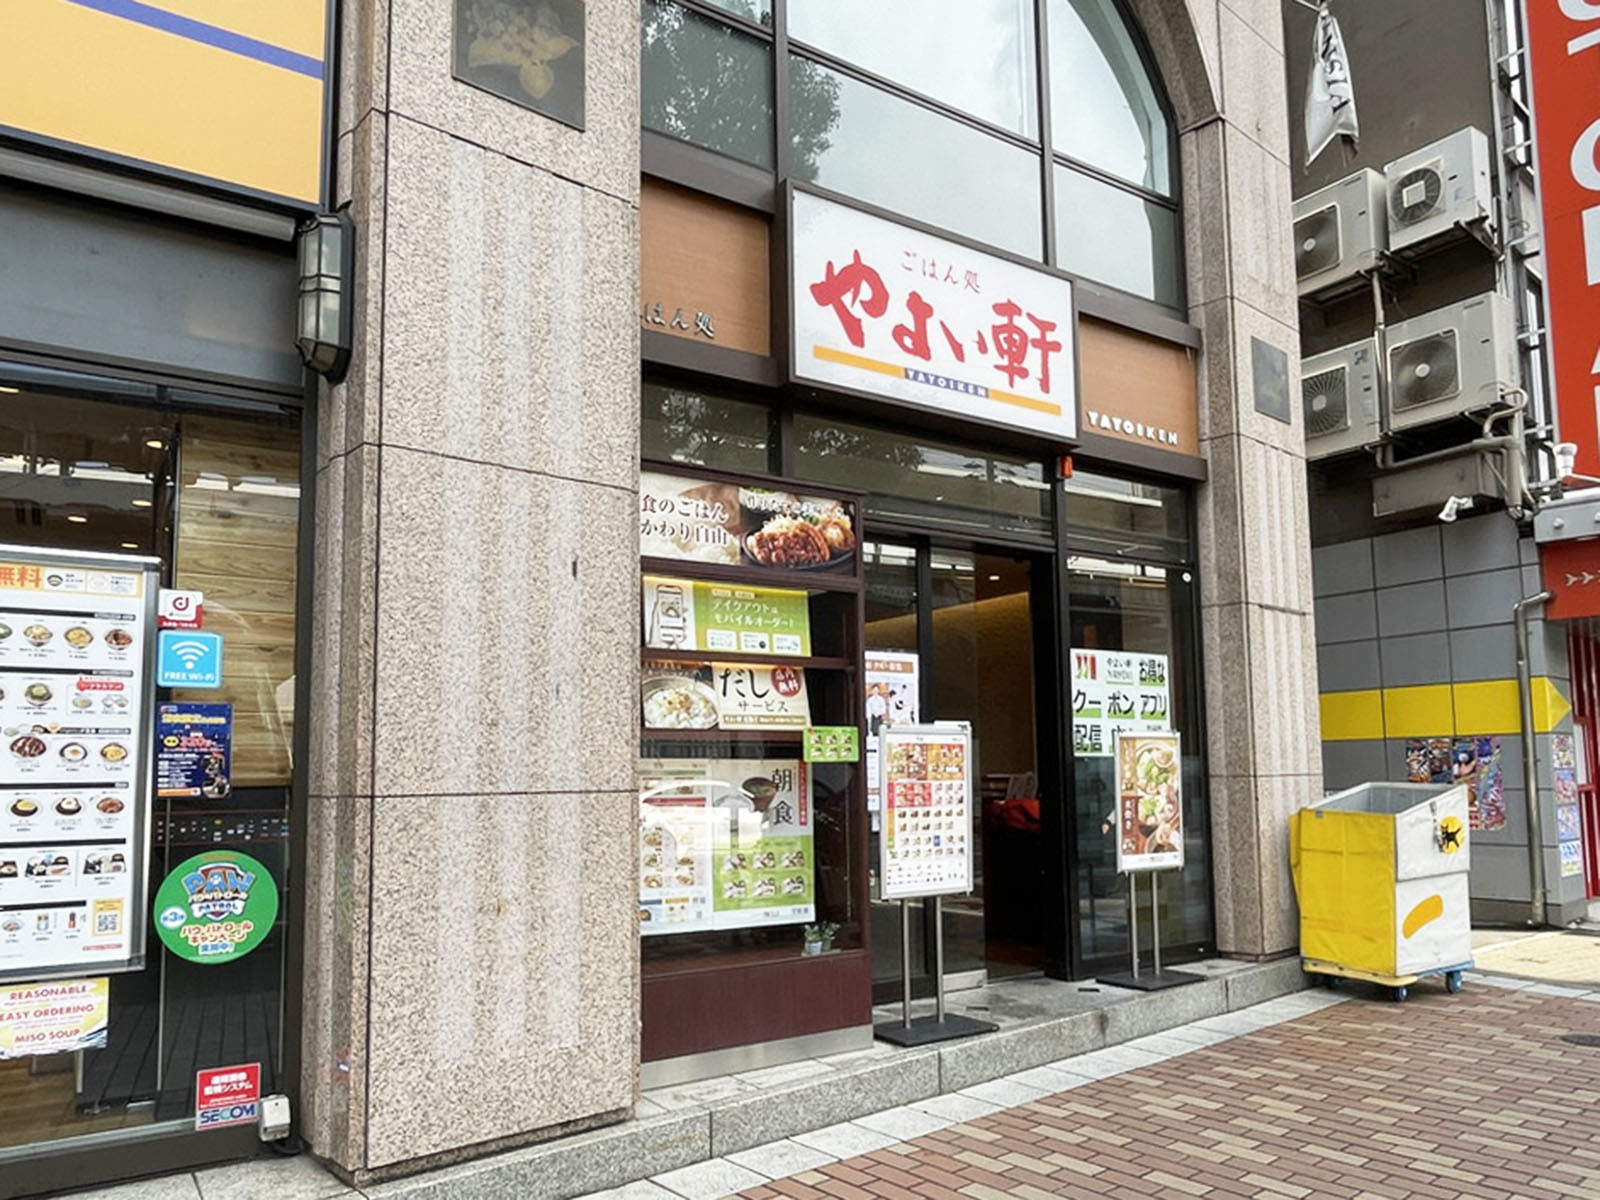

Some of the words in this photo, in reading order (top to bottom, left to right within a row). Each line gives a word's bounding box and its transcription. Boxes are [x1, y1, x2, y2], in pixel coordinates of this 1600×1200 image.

[902, 250, 981, 294] ごはん処
[640, 303, 716, 339] はん処
[810, 249, 1062, 394] やよい軒
[907, 369, 987, 396] YAYOIKEN
[1087, 409, 1178, 447] YAYOIKEN
[641, 493, 729, 522] 食のごはん
[640, 519, 728, 545] かわり自由
[164, 671, 188, 681] FREE
[719, 667, 769, 698] だし
[1139, 659, 1165, 683] お得な
[738, 700, 789, 713] サービス
[772, 768, 793, 825] 朝食
[182, 869, 255, 897] PAW
[198, 901, 240, 912] PATROL
[9, 985, 88, 1000] REASONABLE
[33, 1003, 95, 1018] ORDERING
[14, 1032, 46, 1043] MISO
[49, 1028, 81, 1039] SOUP
[200, 1103, 256, 1124] SECOM
